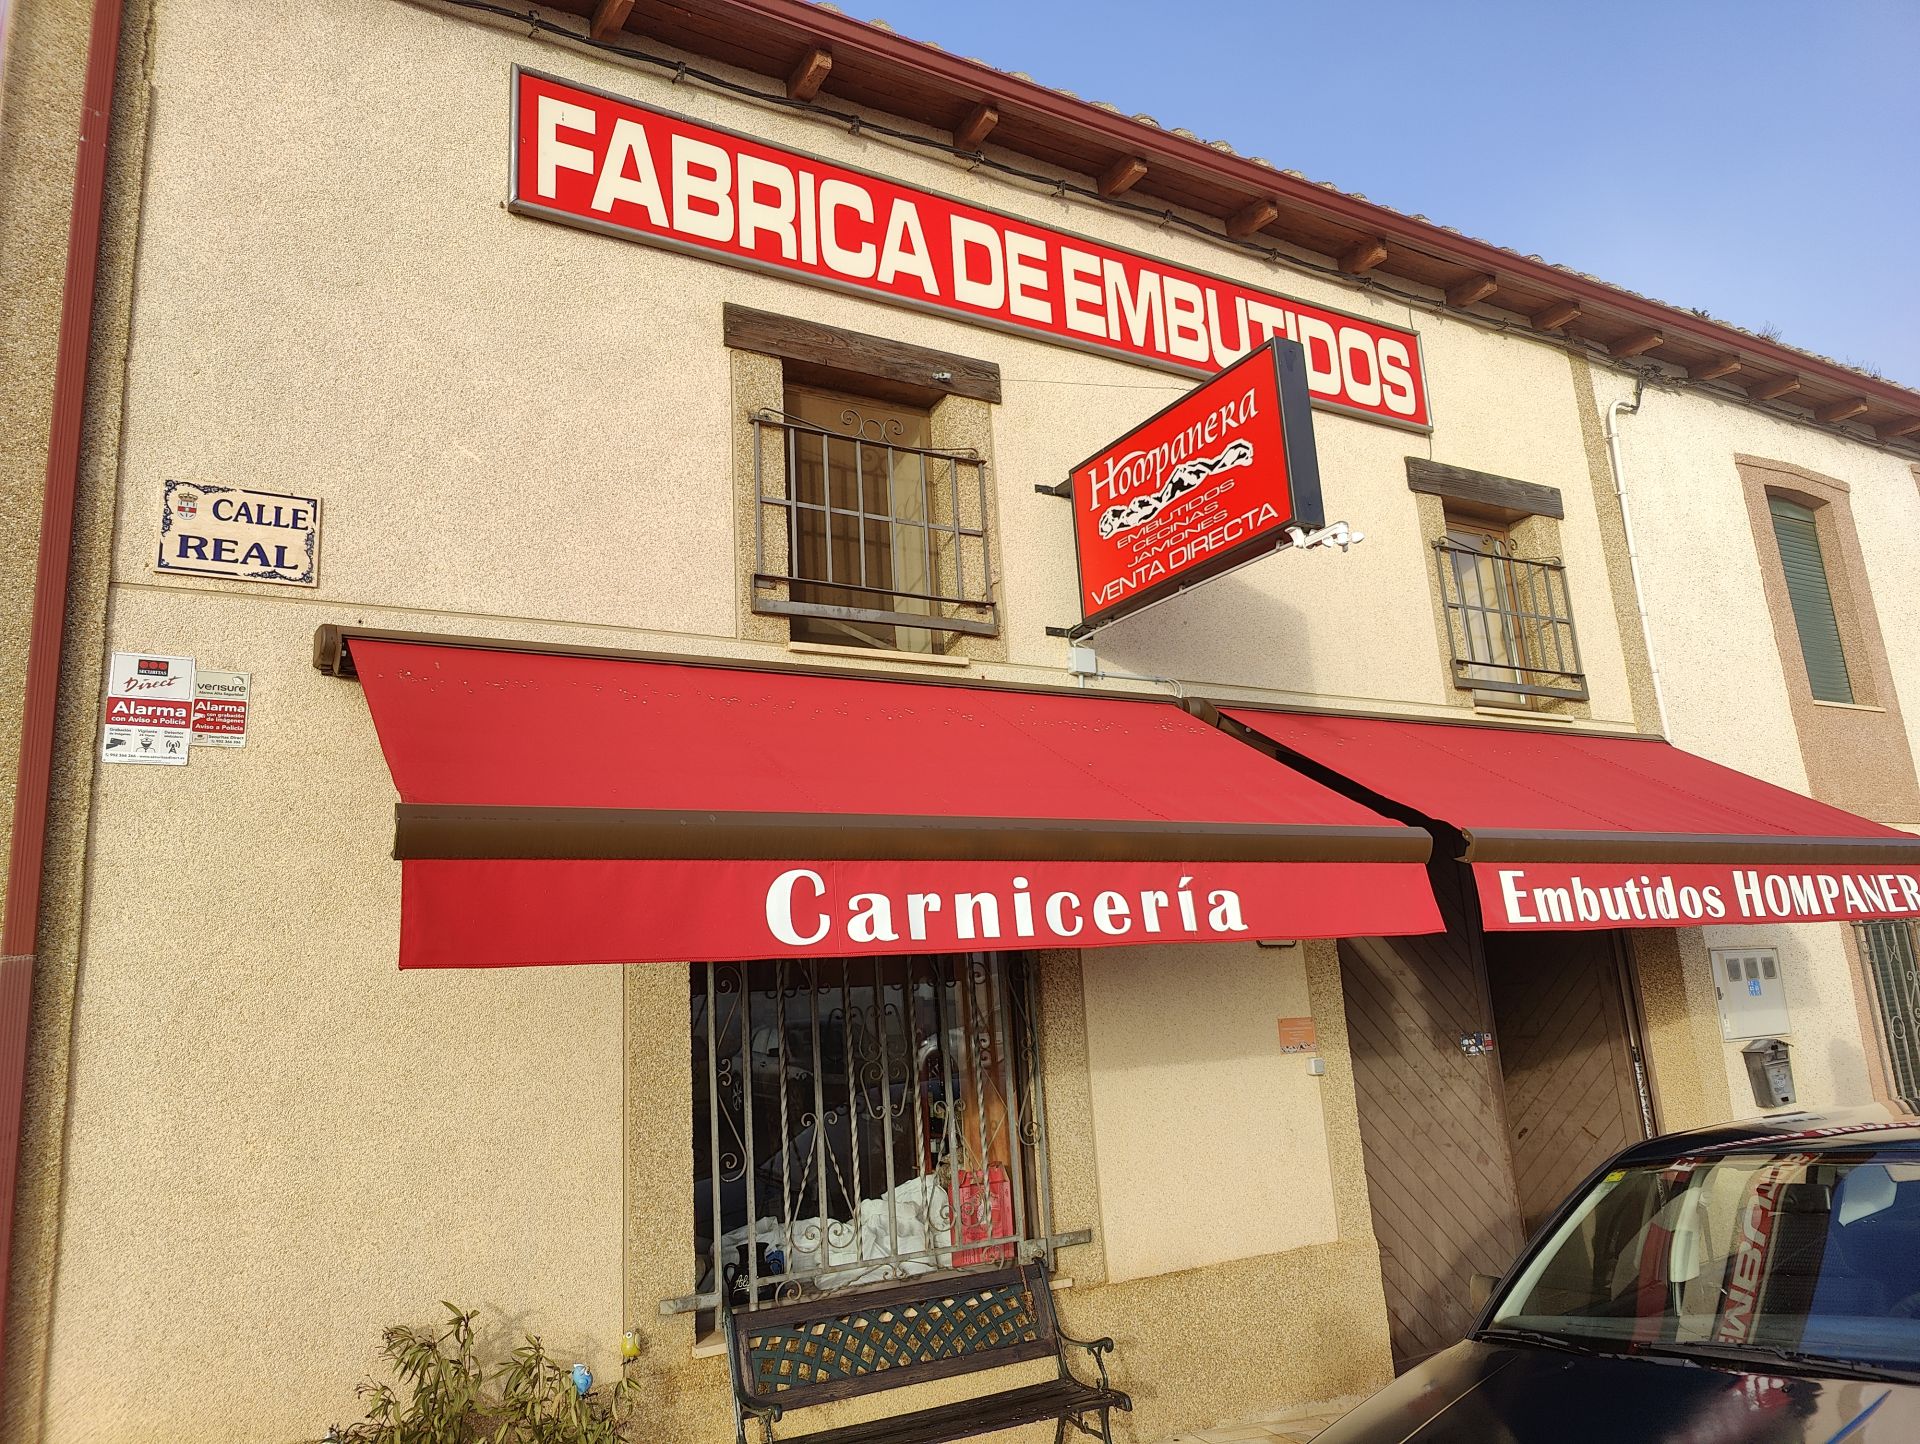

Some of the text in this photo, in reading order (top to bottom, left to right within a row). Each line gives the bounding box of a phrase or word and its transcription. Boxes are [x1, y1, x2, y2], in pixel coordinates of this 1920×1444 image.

[537, 95, 940, 297] FABRICA
[950, 213, 1053, 325] DE
[212, 498, 310, 532] CALLE
[1116, 478, 1236, 549] EMBUTIDOS
[1132, 501, 1220, 553] CECINAS
[175, 533, 299, 570] REAL
[1091, 502, 1279, 605] VENTA DIRECTA
[1127, 509, 1229, 568] JAMONES
[123, 676, 184, 692] Direct
[197, 683, 247, 692] verisure
[112, 700, 187, 717] Alarma
[128, 715, 151, 723] Aviso
[159, 717, 186, 725] Policía
[195, 701, 245, 713] Alarma
[765, 868, 1249, 947] Carnicería
[1498, 869, 1726, 924] Embutidos
